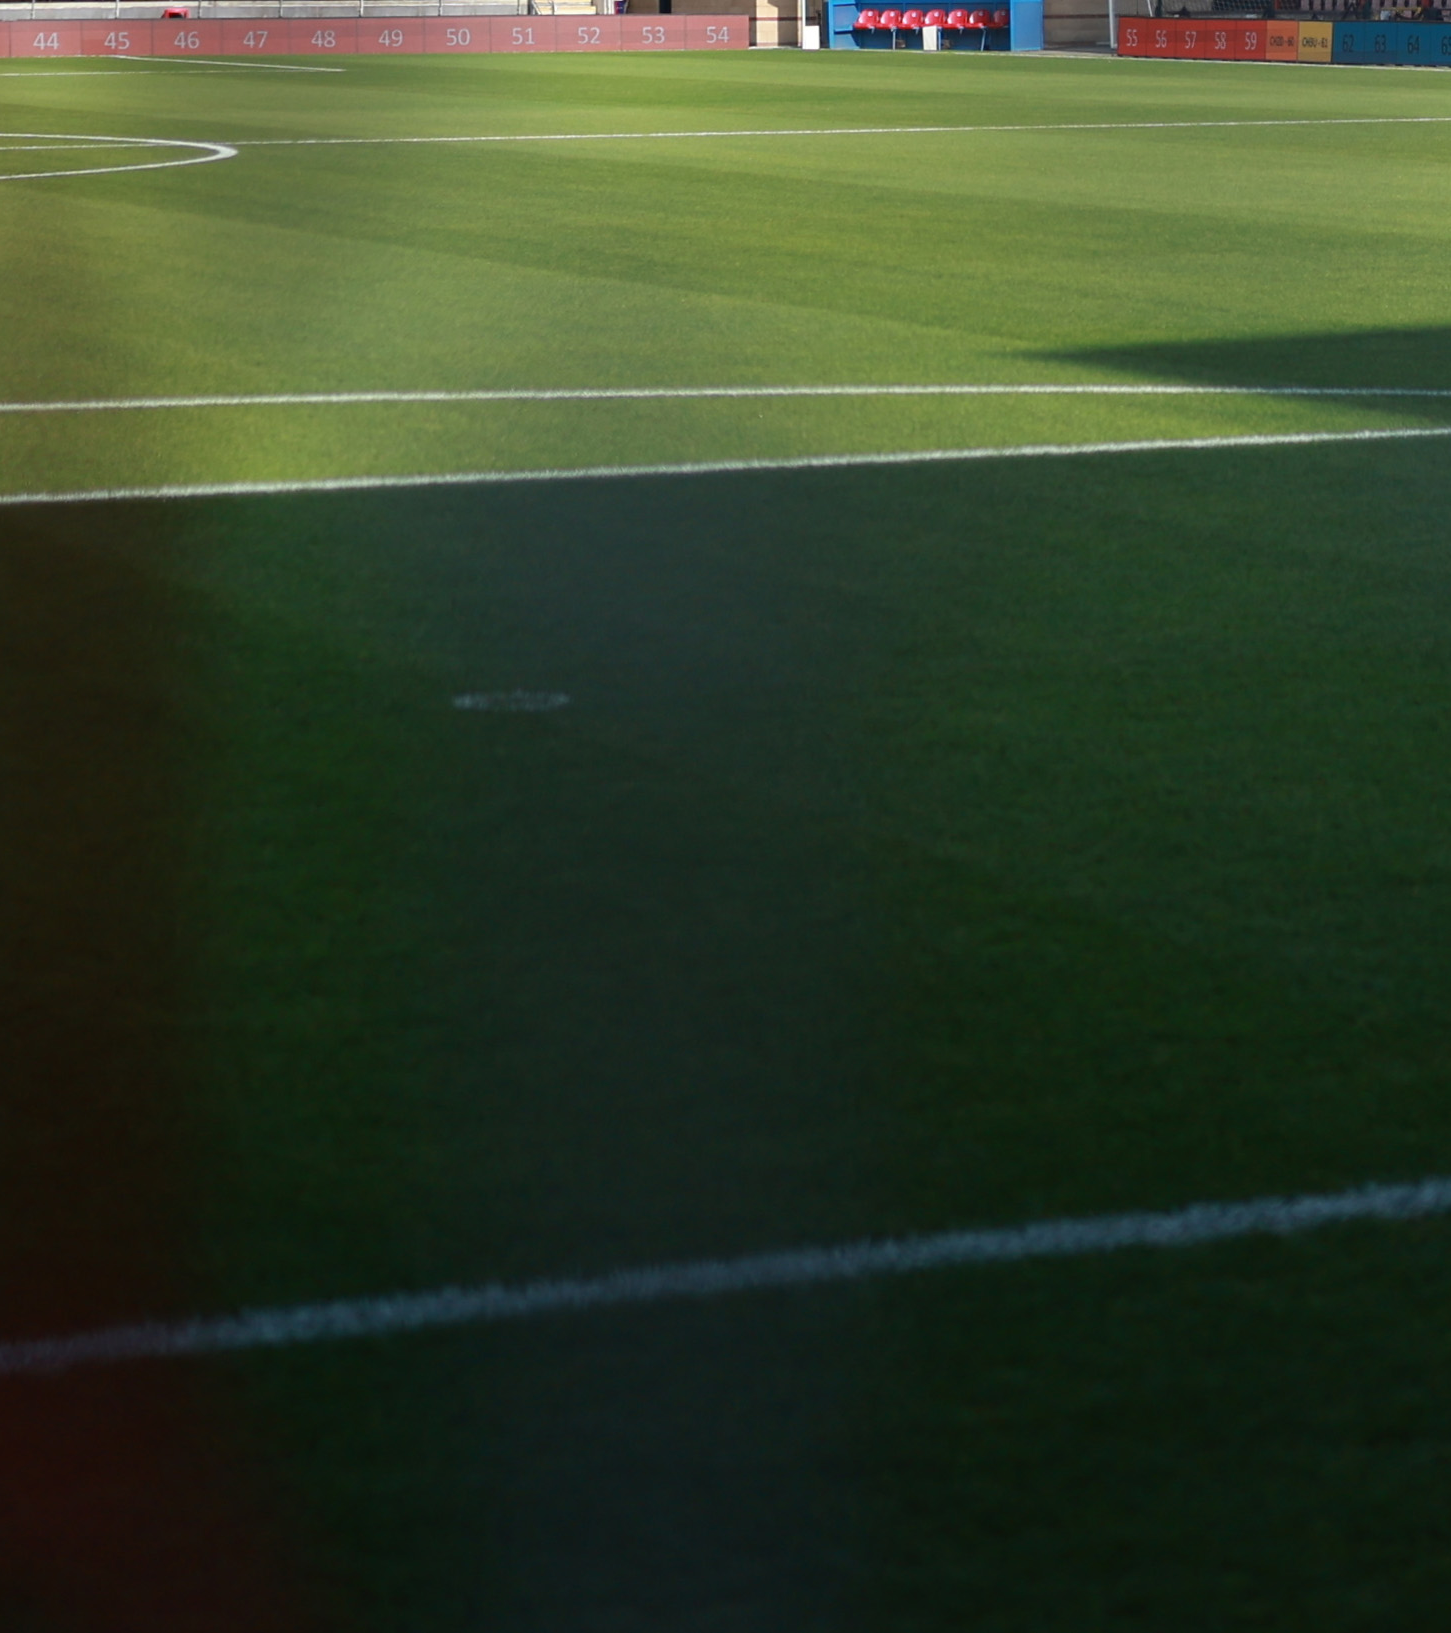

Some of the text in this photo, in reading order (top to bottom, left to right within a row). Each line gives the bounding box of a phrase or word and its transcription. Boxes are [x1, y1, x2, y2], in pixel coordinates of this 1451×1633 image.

[33, 33, 59, 50] 44
[105, 32, 129, 49] 45
[174, 32, 199, 48] 46
[243, 31, 267, 48] 47
[311, 31, 335, 47] 48
[379, 30, 402, 46] 49
[447, 29, 470, 45] 50
[513, 28, 534, 44] 51
[578, 27, 600, 44] 52
[643, 27, 664, 44] 53
[707, 26, 728, 43] 54
[1127, 29, 1256, 50] 55 56 57 58 59
[1342, 34, 1354, 53] 62
[1375, 34, 1386, 53] 63
[1407, 35, 1419, 54] 64
